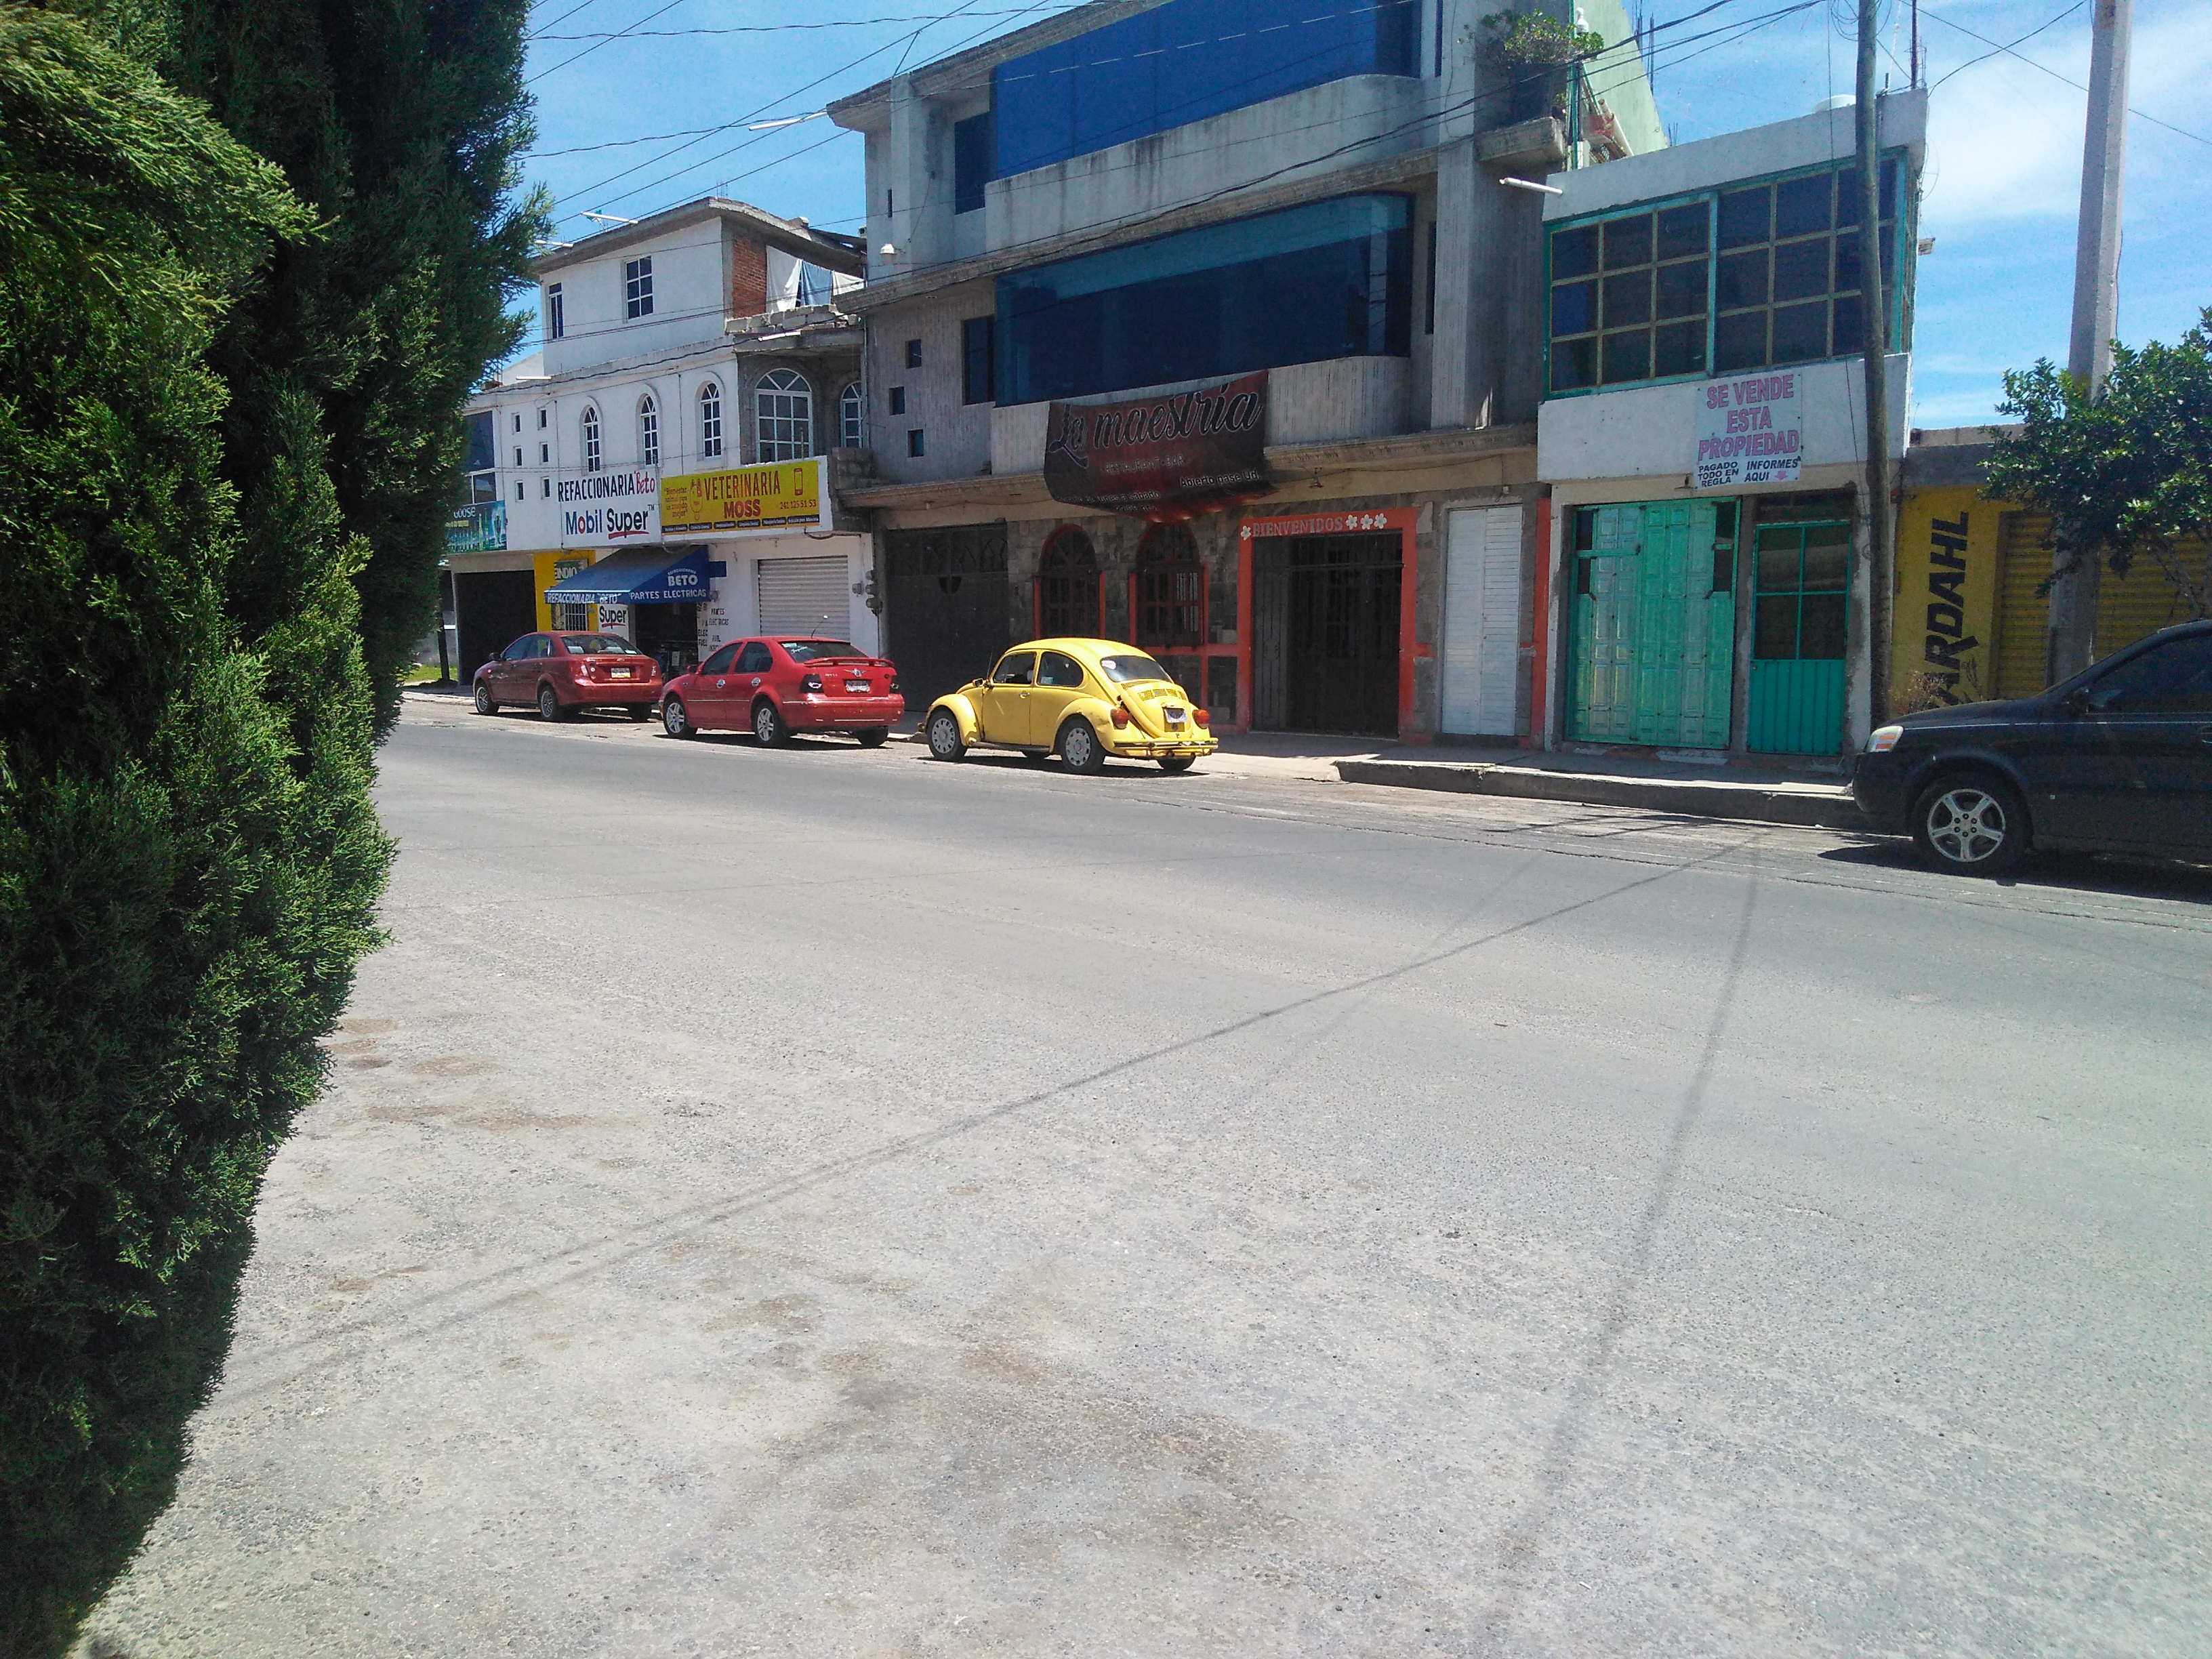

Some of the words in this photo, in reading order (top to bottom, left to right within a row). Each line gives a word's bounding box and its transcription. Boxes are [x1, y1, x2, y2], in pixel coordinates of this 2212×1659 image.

[1706, 384, 1729, 409] SE
[1733, 374, 1795, 405] VENDE
[1727, 406, 1772, 434] ESTA
[1698, 429, 1799, 462] PROPIEDAD
[1165, 453, 1185, 469] BAR
[1699, 461, 1738, 473] PAGADO
[1746, 458, 1799, 470] INFORMES
[1180, 476, 1215, 488] Abierto
[1216, 473, 1241, 485] pase
[1698, 470, 1723, 480] TODO
[1725, 468, 1740, 476] EN
[1701, 476, 1732, 488] REGLA
[1744, 472, 1769, 483] AQUI
[558, 473, 635, 502] REFACCIONARIA
[704, 470, 781, 501] VETERINARIA
[724, 499, 761, 518] MOSS
[565, 510, 602, 535] Mobil
[607, 508, 649, 539] Super
[1253, 516, 1344, 537] BIENVENIDOS
[668, 574, 698, 587] BETO
[548, 592, 595, 604] REFACCIONARIA
[630, 591, 659, 600] PARTES
[663, 589, 707, 598] ELECTRICAS
[599, 605, 627, 629] Super
[1924, 511, 1980, 707] ARDAHL
